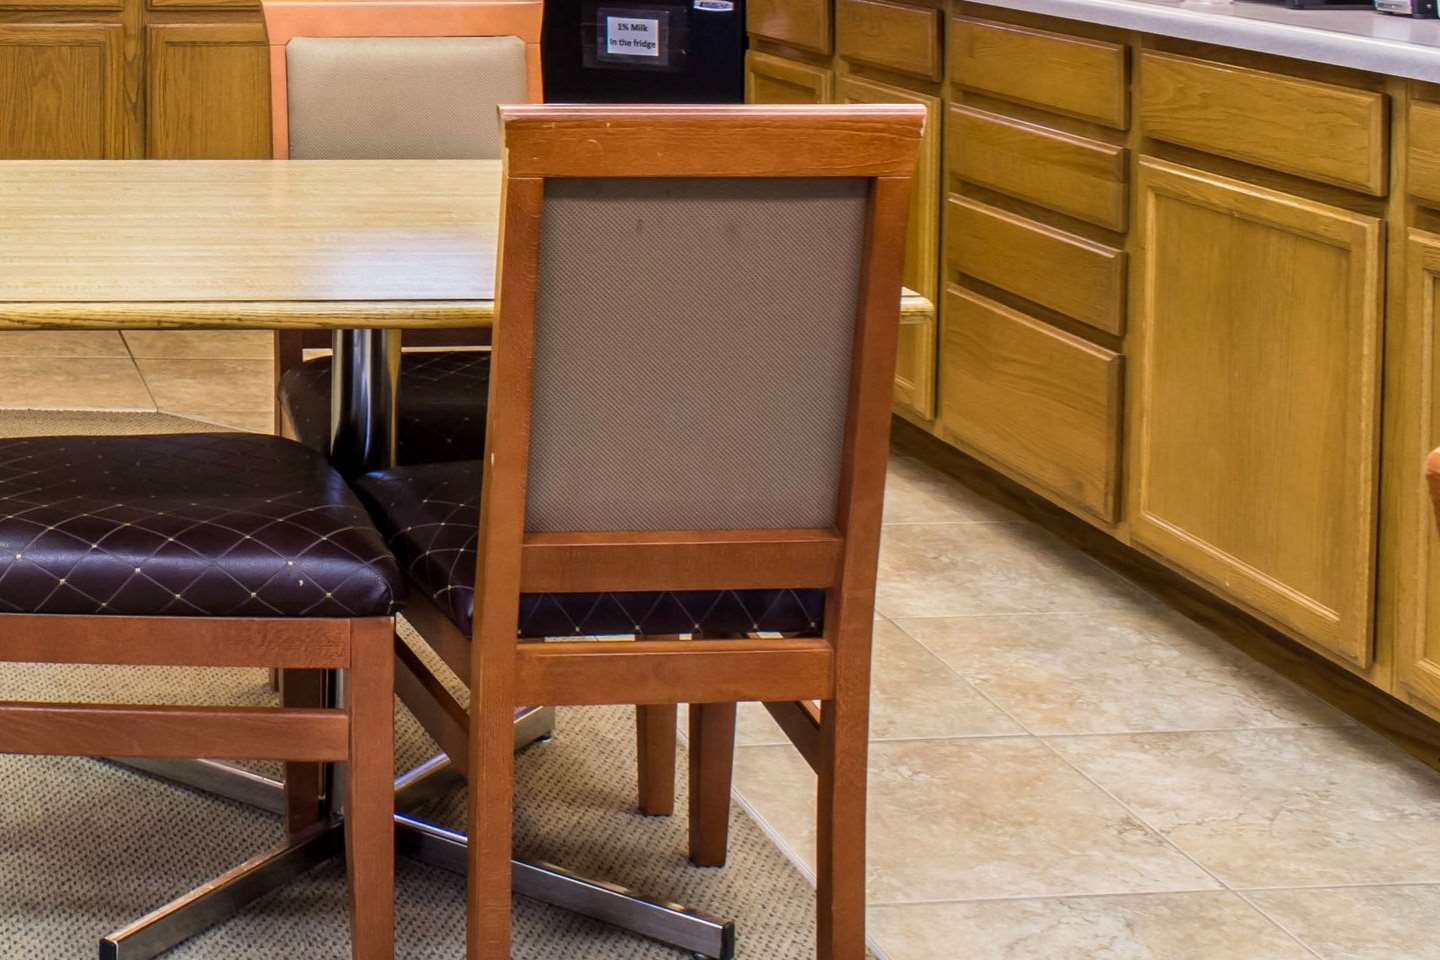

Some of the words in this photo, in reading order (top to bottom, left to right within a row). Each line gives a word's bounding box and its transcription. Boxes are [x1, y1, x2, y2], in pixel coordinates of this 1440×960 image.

[630, 23, 649, 32] Milk
[618, 38, 632, 48] the
[633, 38, 656, 50] fridge
